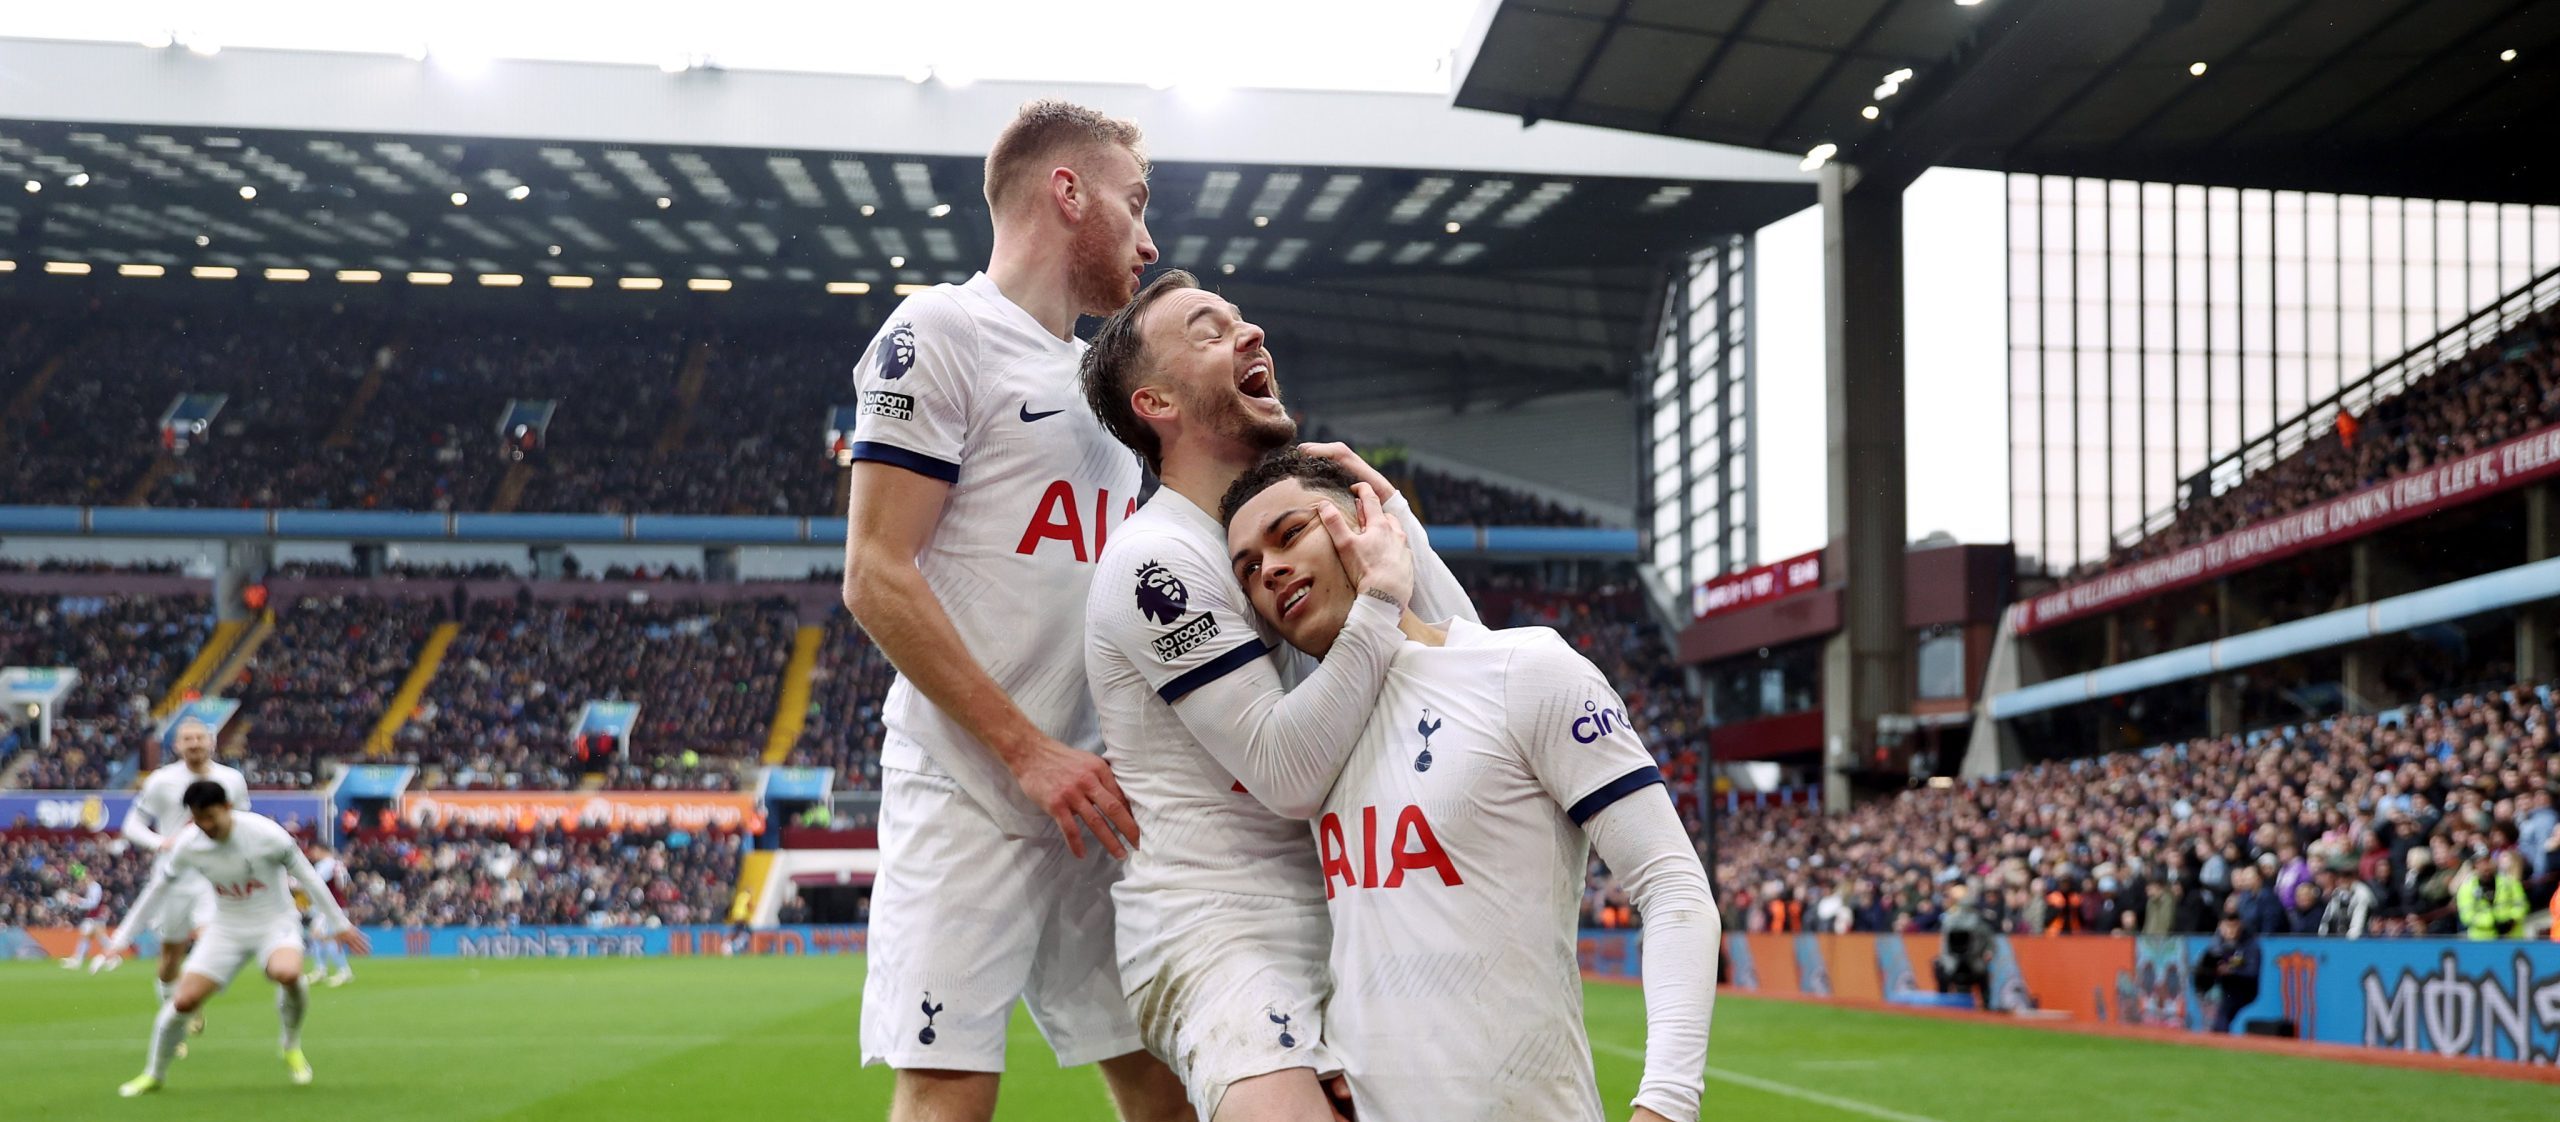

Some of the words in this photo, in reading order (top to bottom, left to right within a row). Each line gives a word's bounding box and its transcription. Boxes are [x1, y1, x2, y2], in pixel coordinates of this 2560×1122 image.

[872, 404, 912, 420] racism
[874, 393, 908, 408] room
[2328, 485, 2391, 532] DOWN
[2393, 470, 2438, 510] THE
[1016, 480, 1137, 563] AI
[1152, 638, 1174, 653] No
[1173, 617, 1210, 643] room
[1159, 646, 1178, 663] for
[1178, 624, 1220, 654] racism
[1321, 804, 1464, 899] AIA
